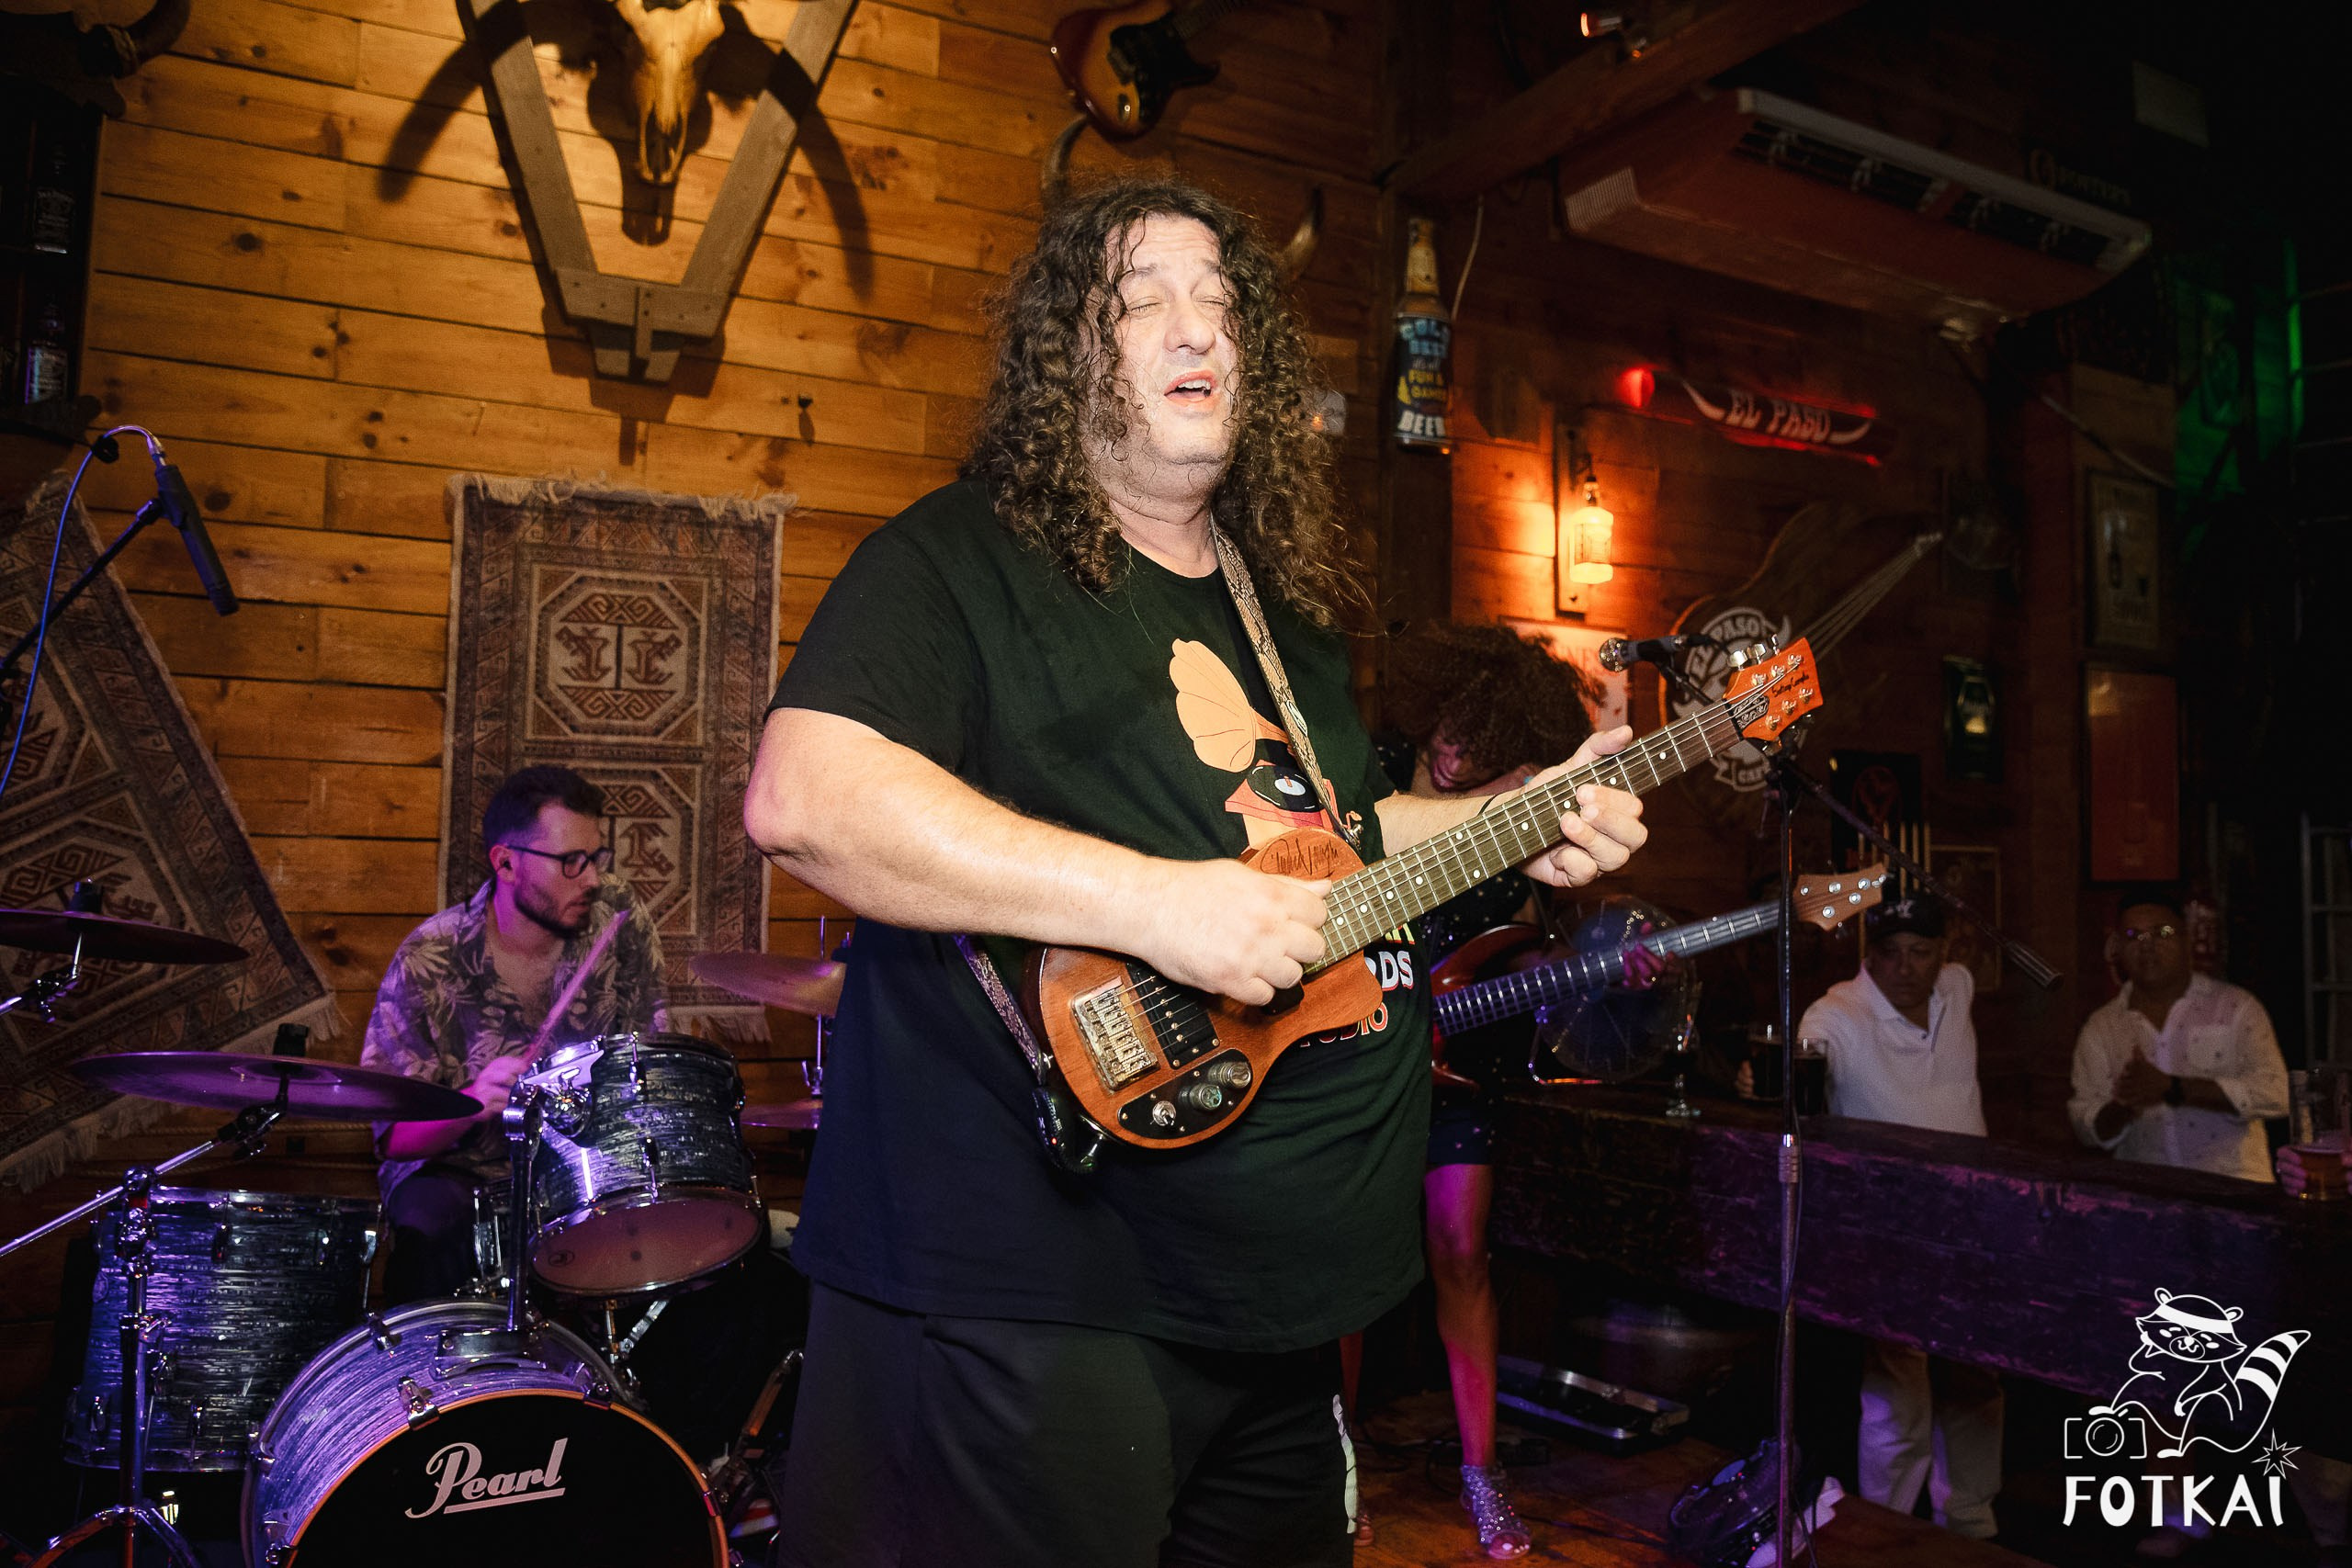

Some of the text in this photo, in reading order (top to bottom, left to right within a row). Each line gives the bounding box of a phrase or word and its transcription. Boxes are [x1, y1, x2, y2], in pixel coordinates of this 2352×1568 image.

[1724, 388, 1832, 445] EL PASO
[1709, 616, 1760, 643] PASO
[404, 1437, 569, 1518] Pearl
